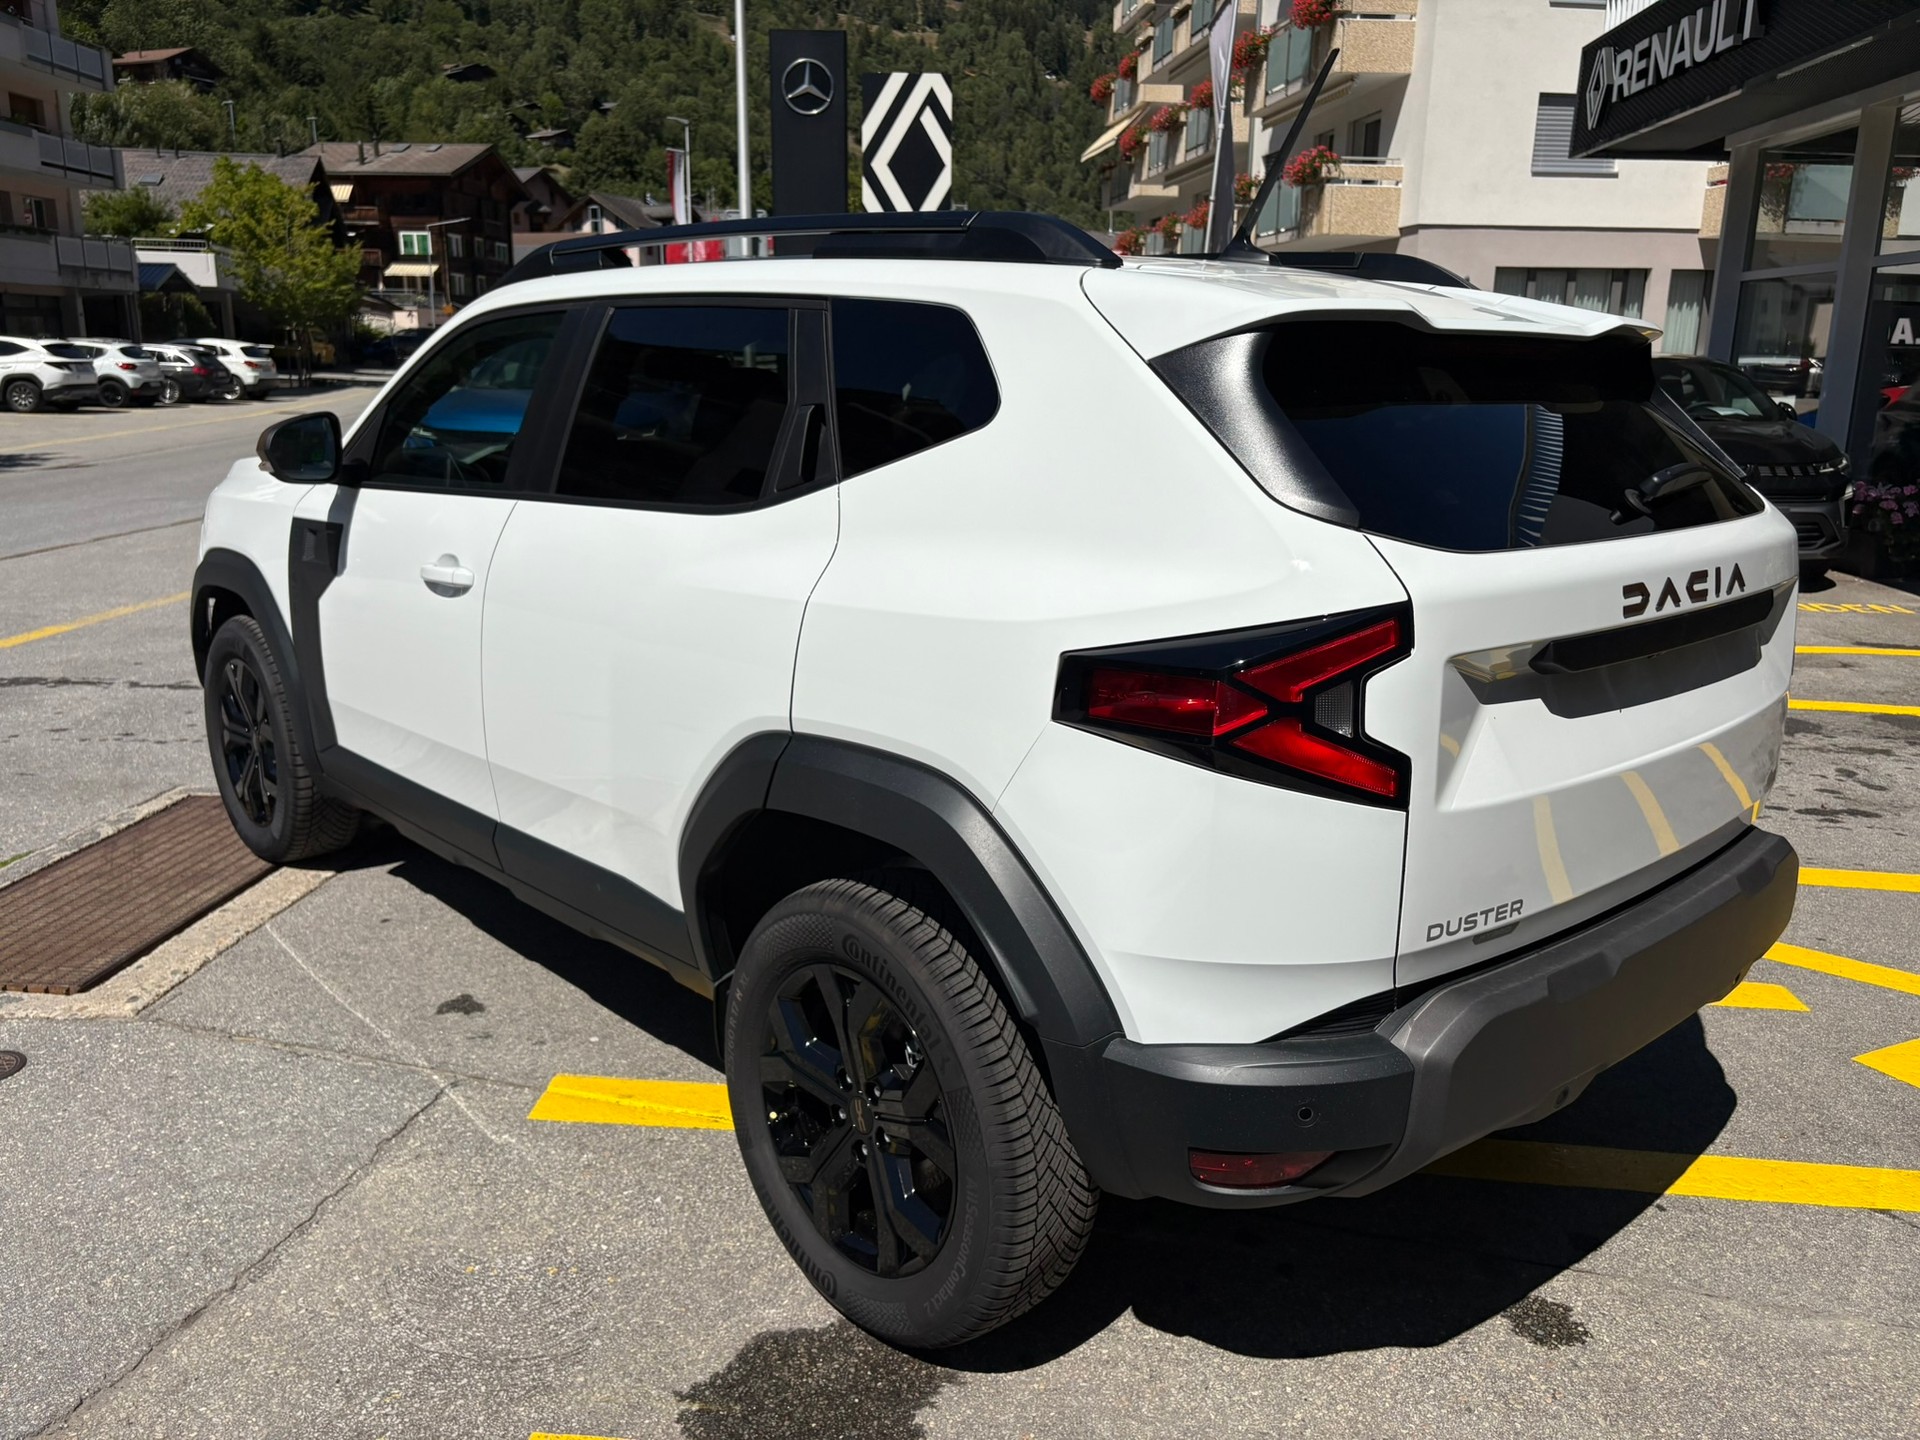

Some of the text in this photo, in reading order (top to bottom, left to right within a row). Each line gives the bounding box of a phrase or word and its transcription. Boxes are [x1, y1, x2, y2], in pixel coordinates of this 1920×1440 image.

[1622, 562, 1746, 619] DACIA
[1426, 898, 1524, 942] DUSTER
[842, 933, 942, 1048] Continental
